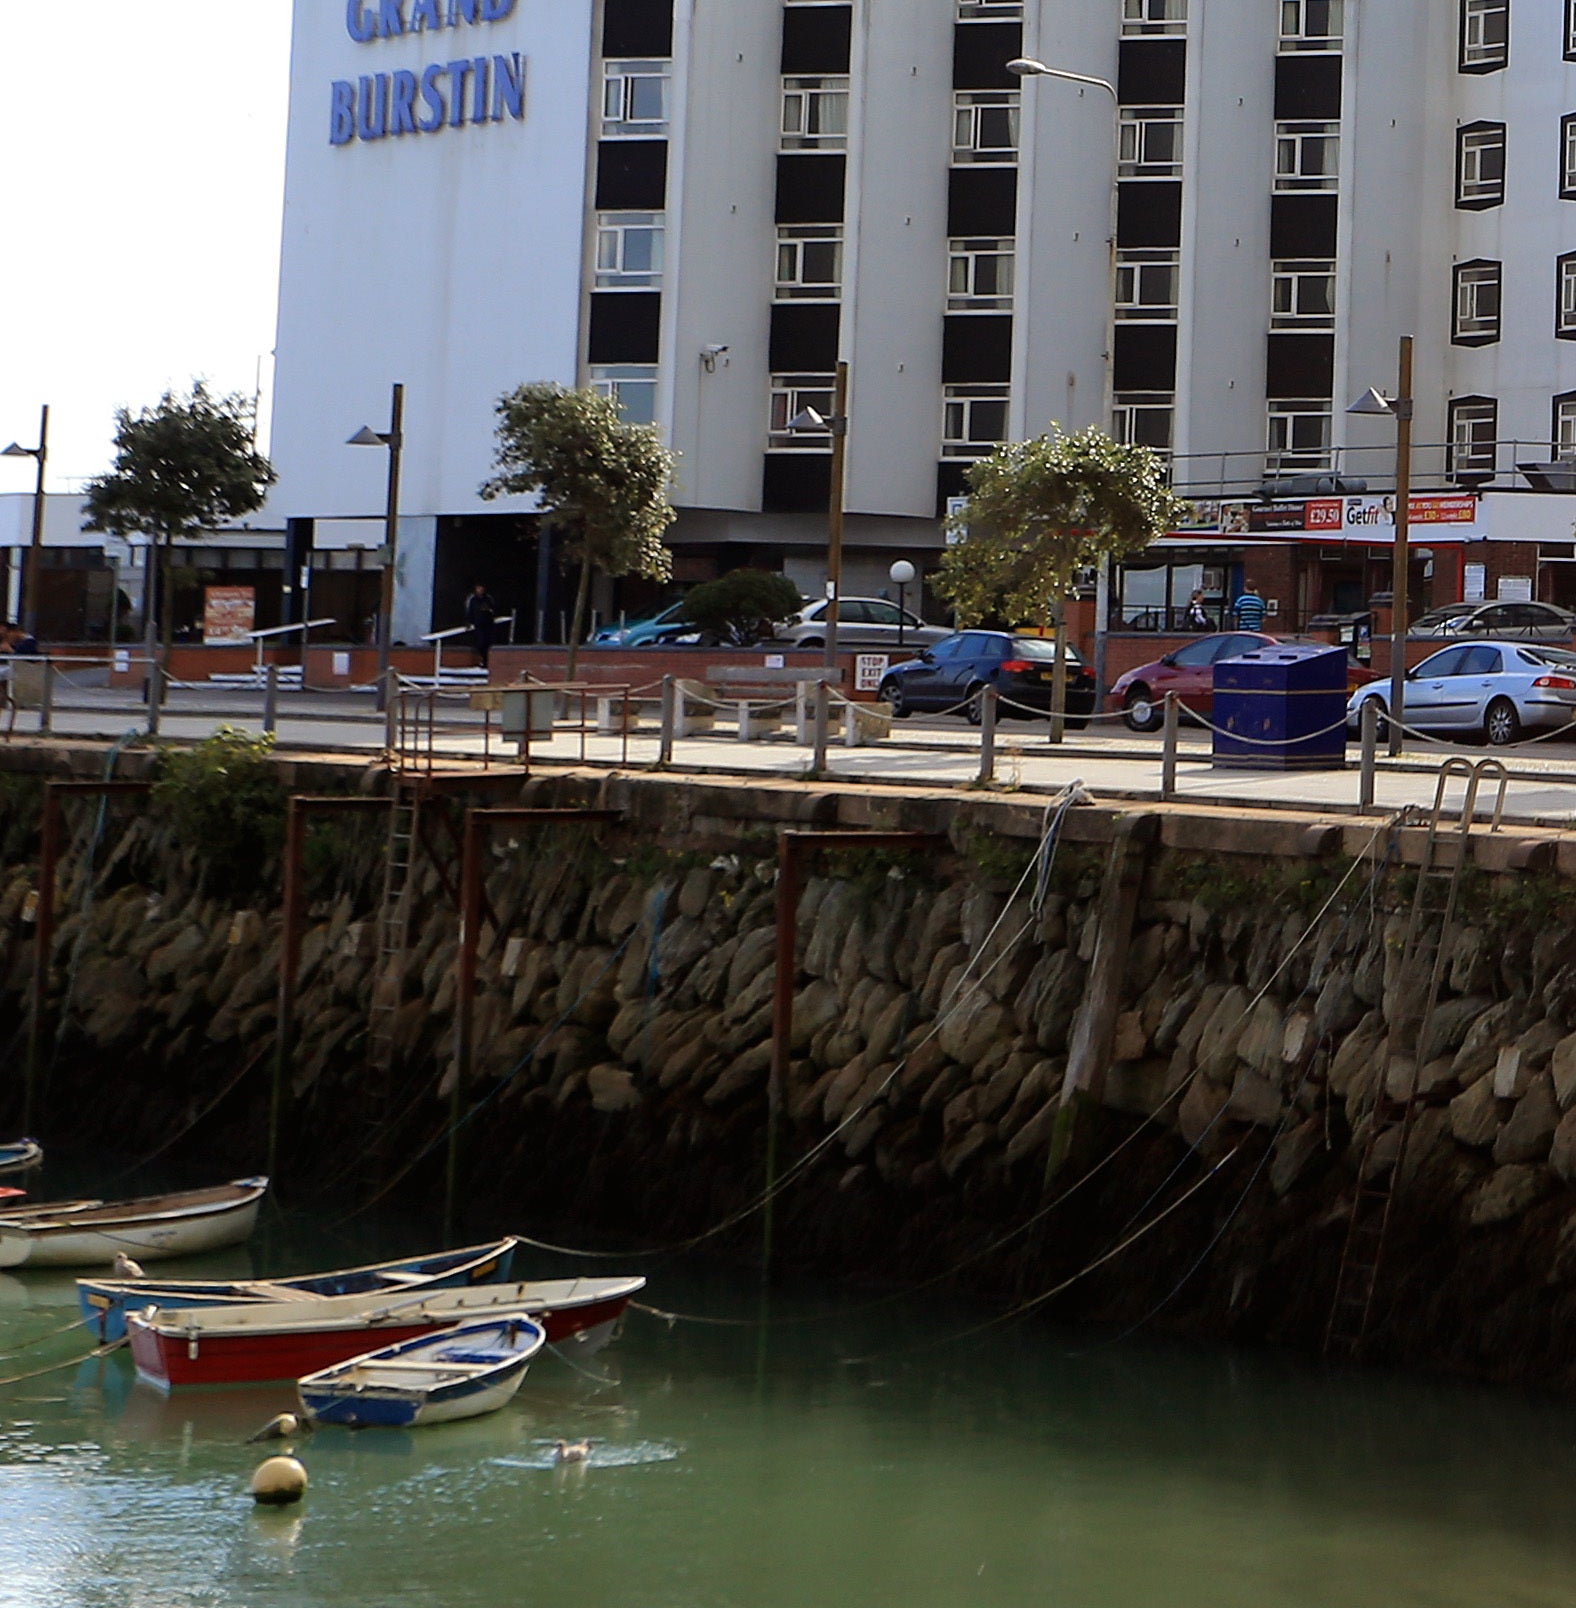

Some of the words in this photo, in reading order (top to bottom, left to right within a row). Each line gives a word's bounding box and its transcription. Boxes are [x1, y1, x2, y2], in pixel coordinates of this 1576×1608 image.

[330, 52, 526, 145] BURSTIN
[1310, 508, 1340, 523] £29.50
[1346, 505, 1380, 525] Getfit
[861, 657, 885, 666] STOP
[862, 668, 881, 677] EXIT
